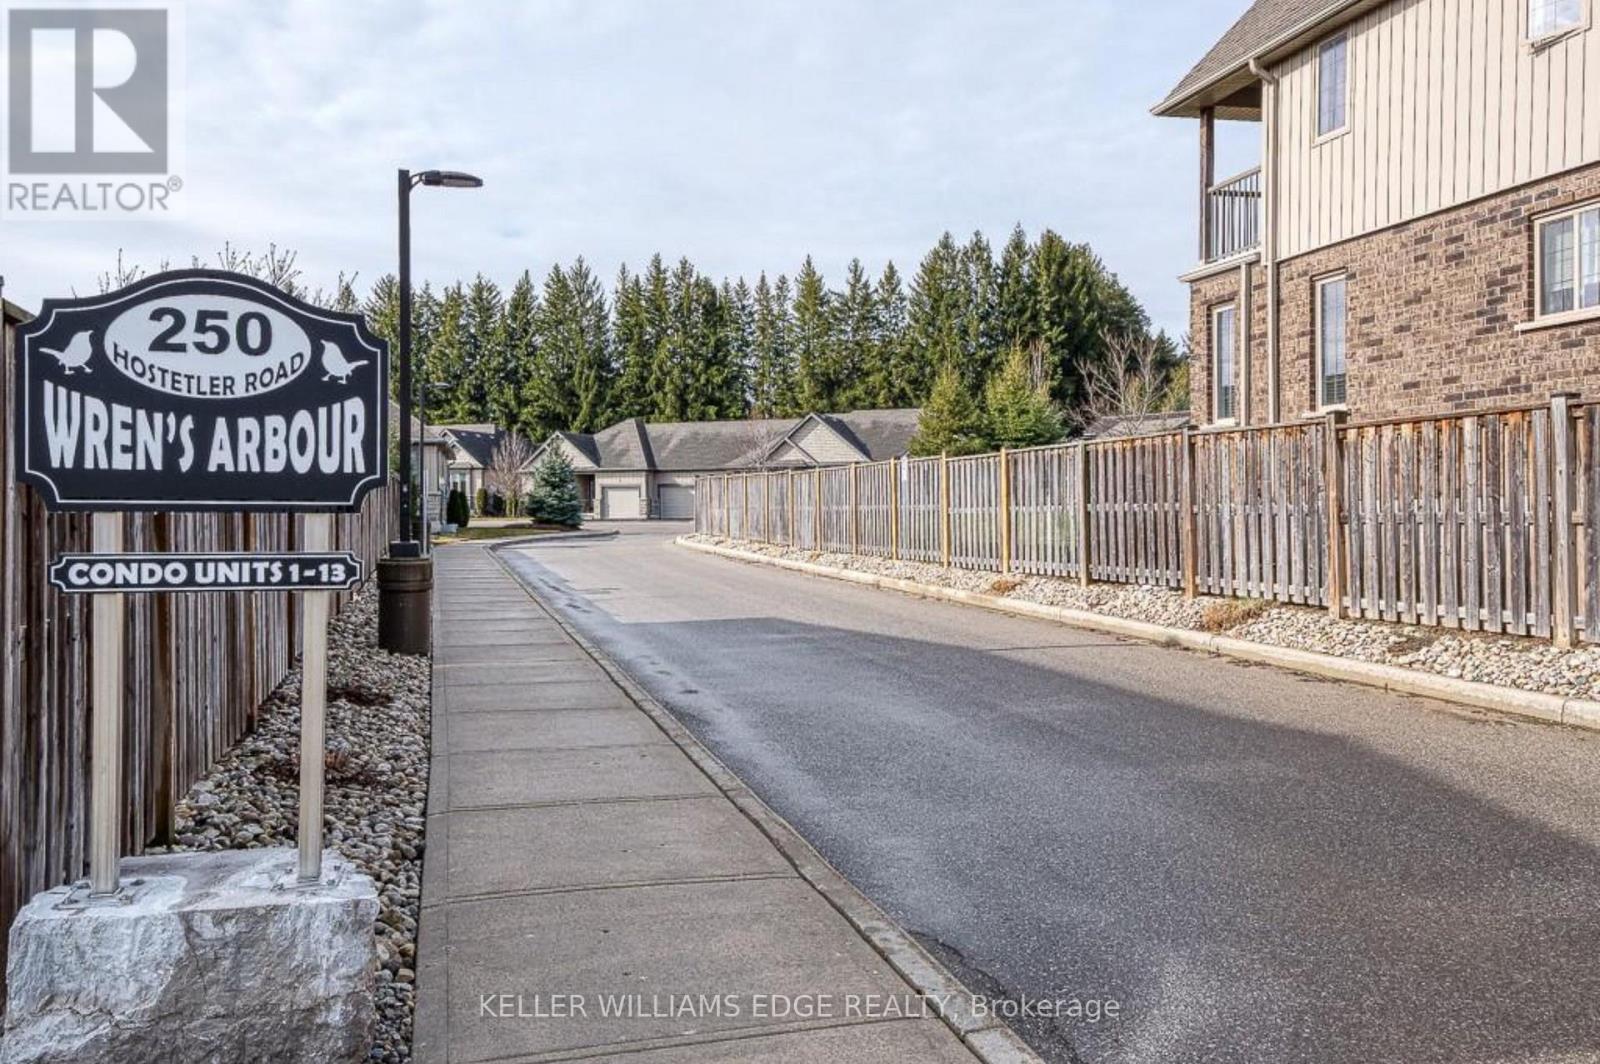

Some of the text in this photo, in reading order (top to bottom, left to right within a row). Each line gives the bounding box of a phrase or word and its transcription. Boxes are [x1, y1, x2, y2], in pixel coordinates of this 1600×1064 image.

[148, 307, 272, 356] 250
[113, 344, 304, 396] HOSTETLER ROAD
[43, 380, 366, 474] WREN'S ARBOUR
[67, 562, 346, 585] CONDO UNITS 1-13
